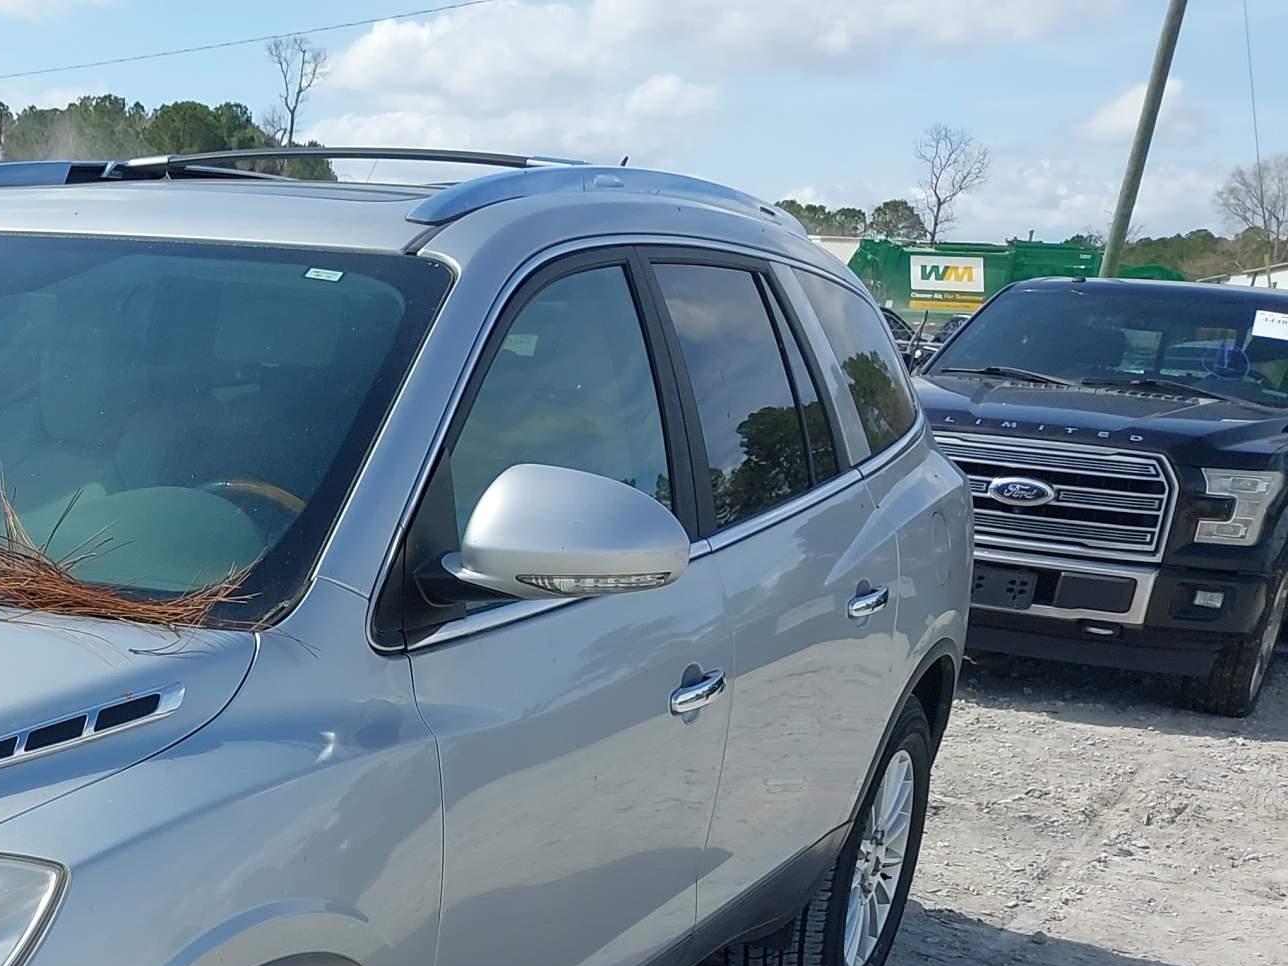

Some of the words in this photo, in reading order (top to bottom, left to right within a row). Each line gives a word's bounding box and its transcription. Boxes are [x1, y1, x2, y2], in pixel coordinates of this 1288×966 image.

[920, 265, 974, 282] WM
[944, 415, 1144, 442] LIMITED
[1002, 483, 1038, 500] Ford
